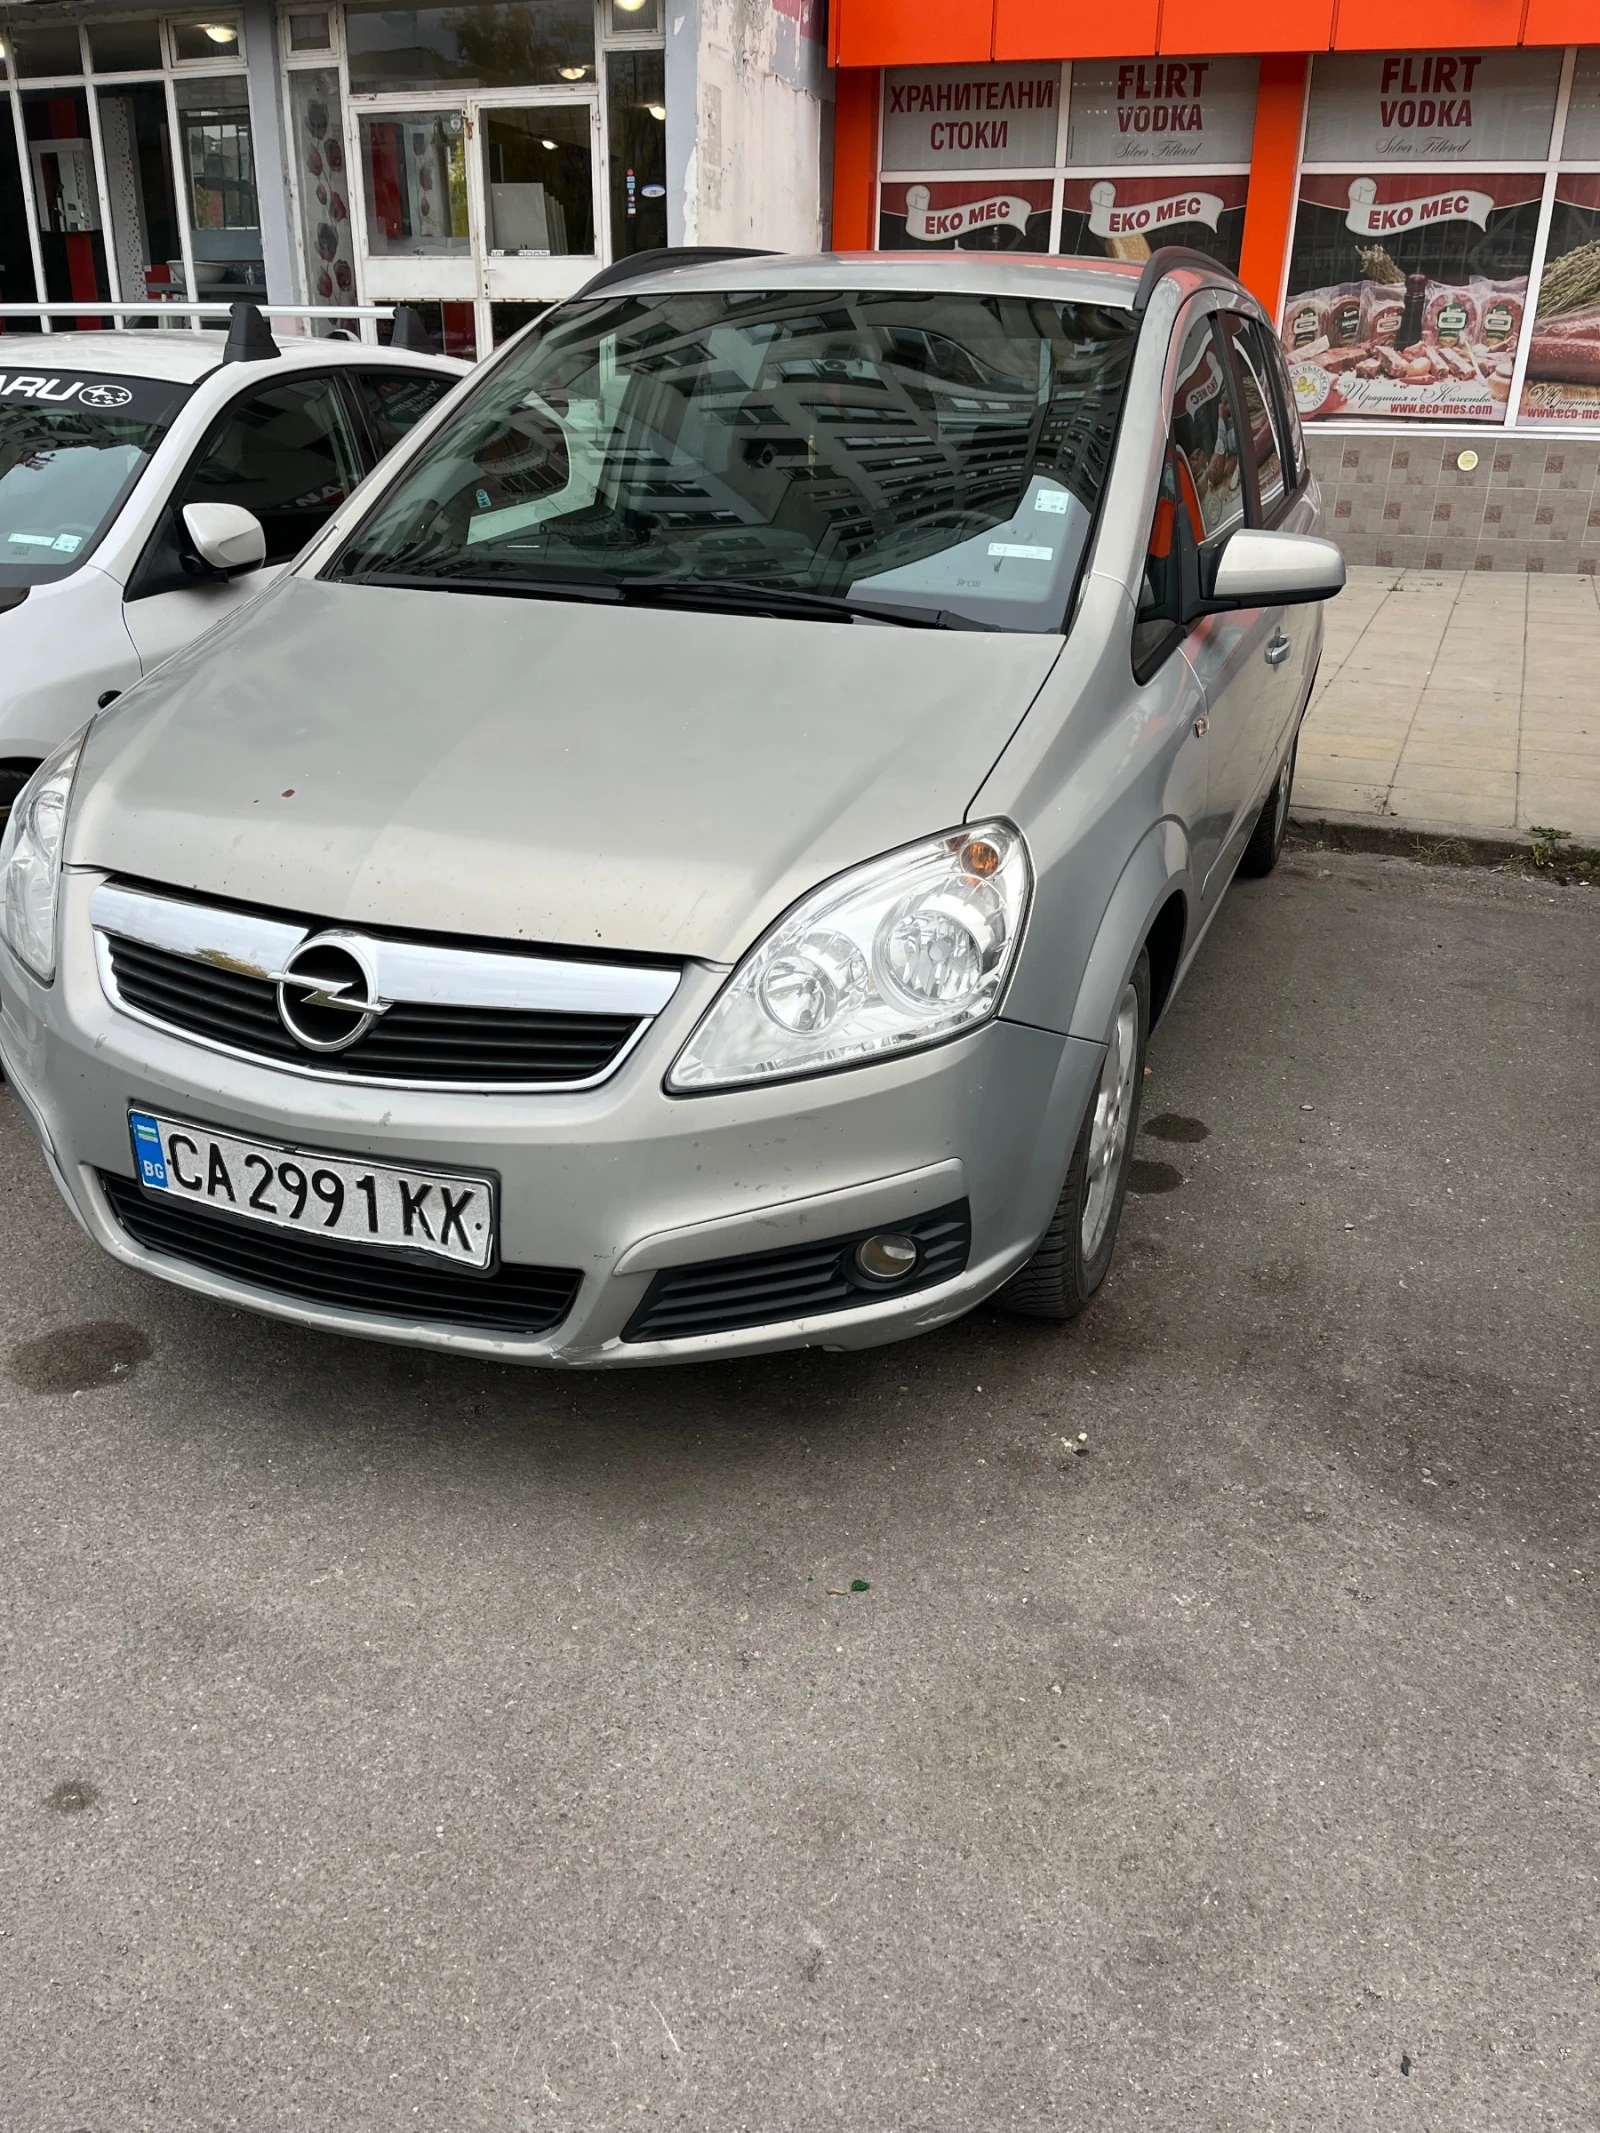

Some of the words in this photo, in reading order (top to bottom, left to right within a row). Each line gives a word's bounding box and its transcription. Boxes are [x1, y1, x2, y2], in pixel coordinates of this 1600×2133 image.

[1117, 62, 1209, 100] FLIRT
[1380, 56, 1482, 94] FLIRT
[889, 80, 1054, 114] ХРАНИТЕЛНИ
[1117, 104, 1203, 133] VODKA
[1380, 100, 1473, 128] VODKA
[930, 121, 1009, 151] СТОКИ
[1115, 140, 1149, 159] Silver
[1151, 140, 1202, 160] Filtered
[1374, 134, 1413, 155] Silver
[1415, 136, 1472, 155] Filtered
[1390, 403, 1493, 415] www.eco-mes.com
[1527, 408, 1600, 419] www.eco-me
[143, 1160, 165, 1179] BG
